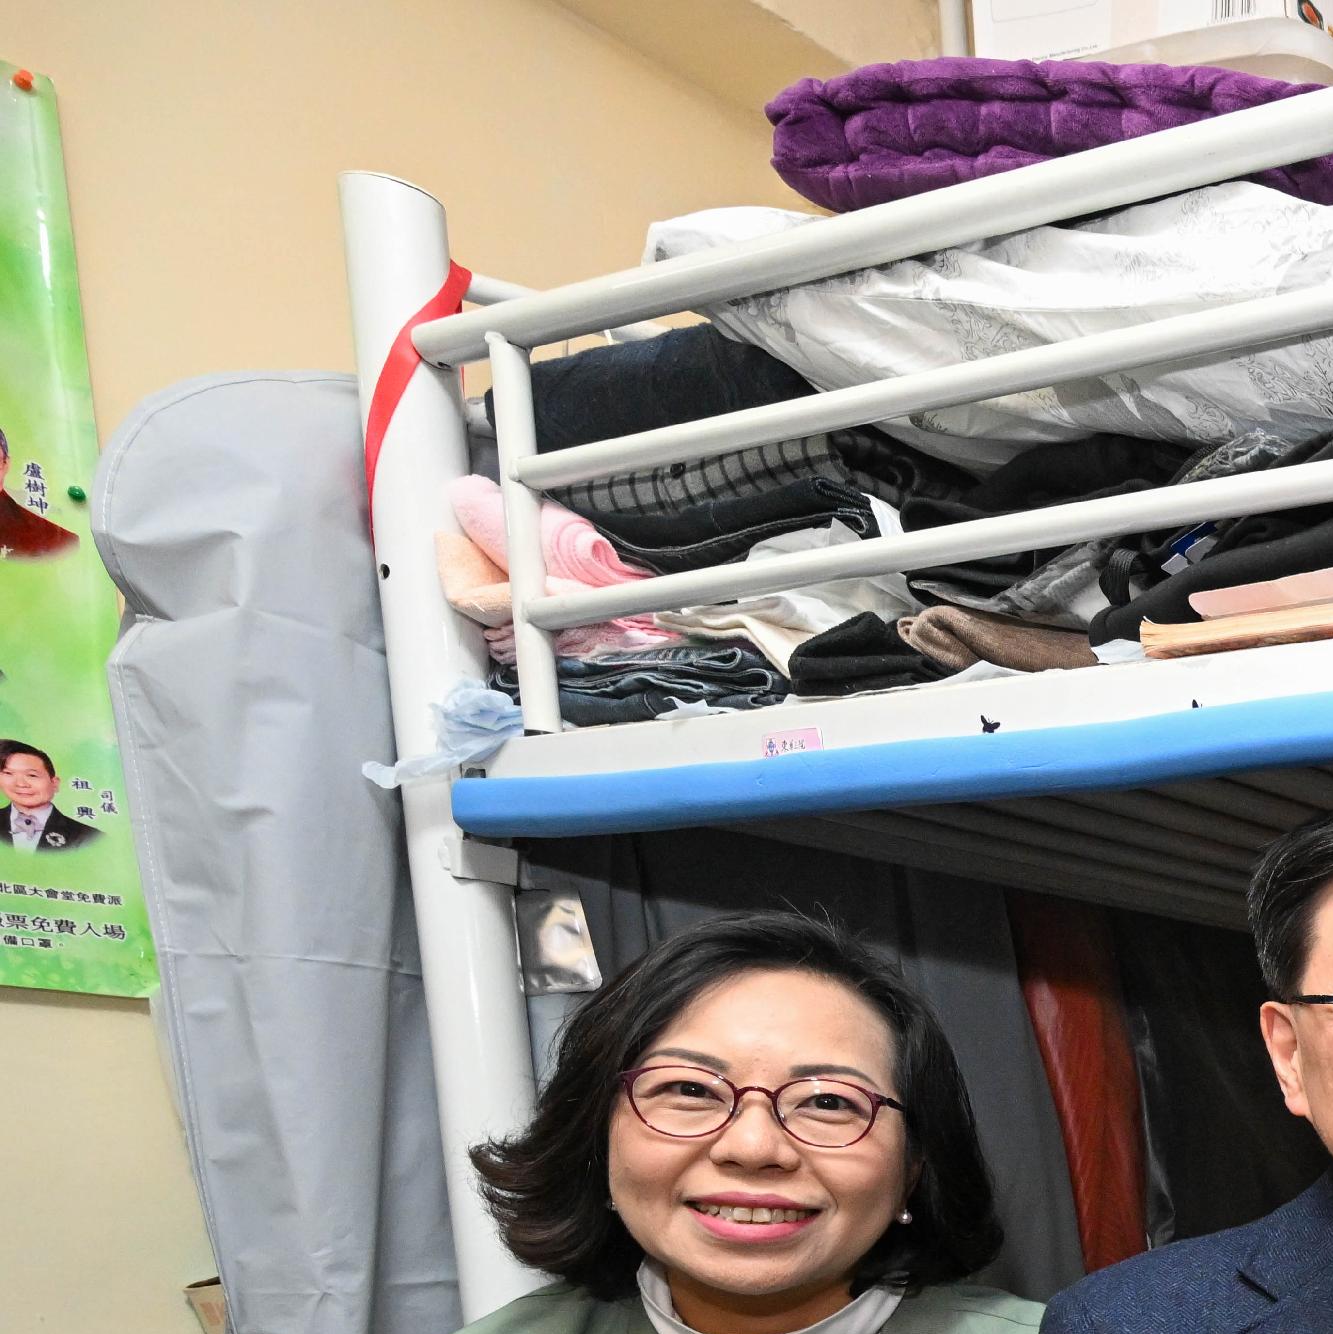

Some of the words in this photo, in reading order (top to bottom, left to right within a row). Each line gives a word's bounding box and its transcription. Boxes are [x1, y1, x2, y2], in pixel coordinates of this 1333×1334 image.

[23, 462, 49, 515] 盧樹坤
[101, 790, 118, 815] 司儀
[0, 912, 126, 940] 票免費入場
